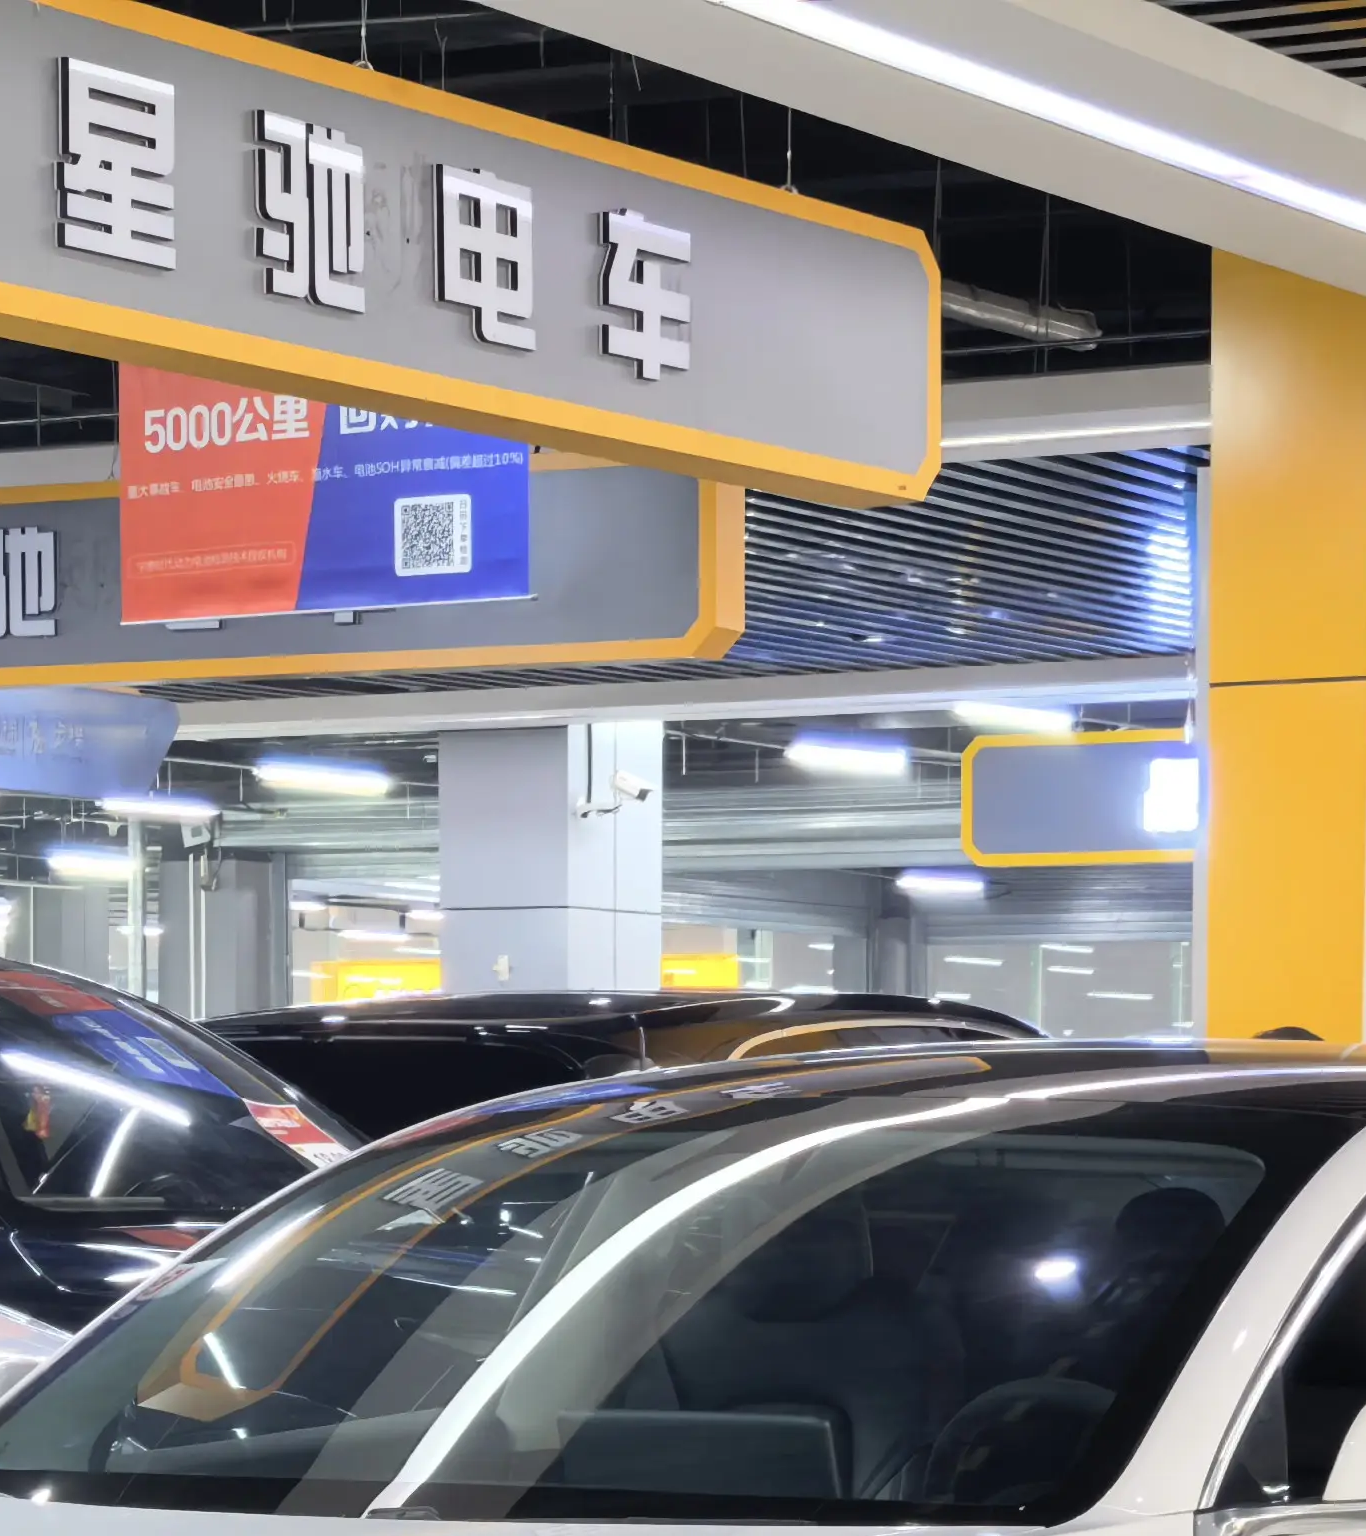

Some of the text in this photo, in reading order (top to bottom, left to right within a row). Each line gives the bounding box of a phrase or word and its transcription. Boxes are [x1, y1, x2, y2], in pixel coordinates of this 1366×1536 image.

[55, 56, 692, 381] 星驰电车
[144, 394, 310, 454] 5000公里
